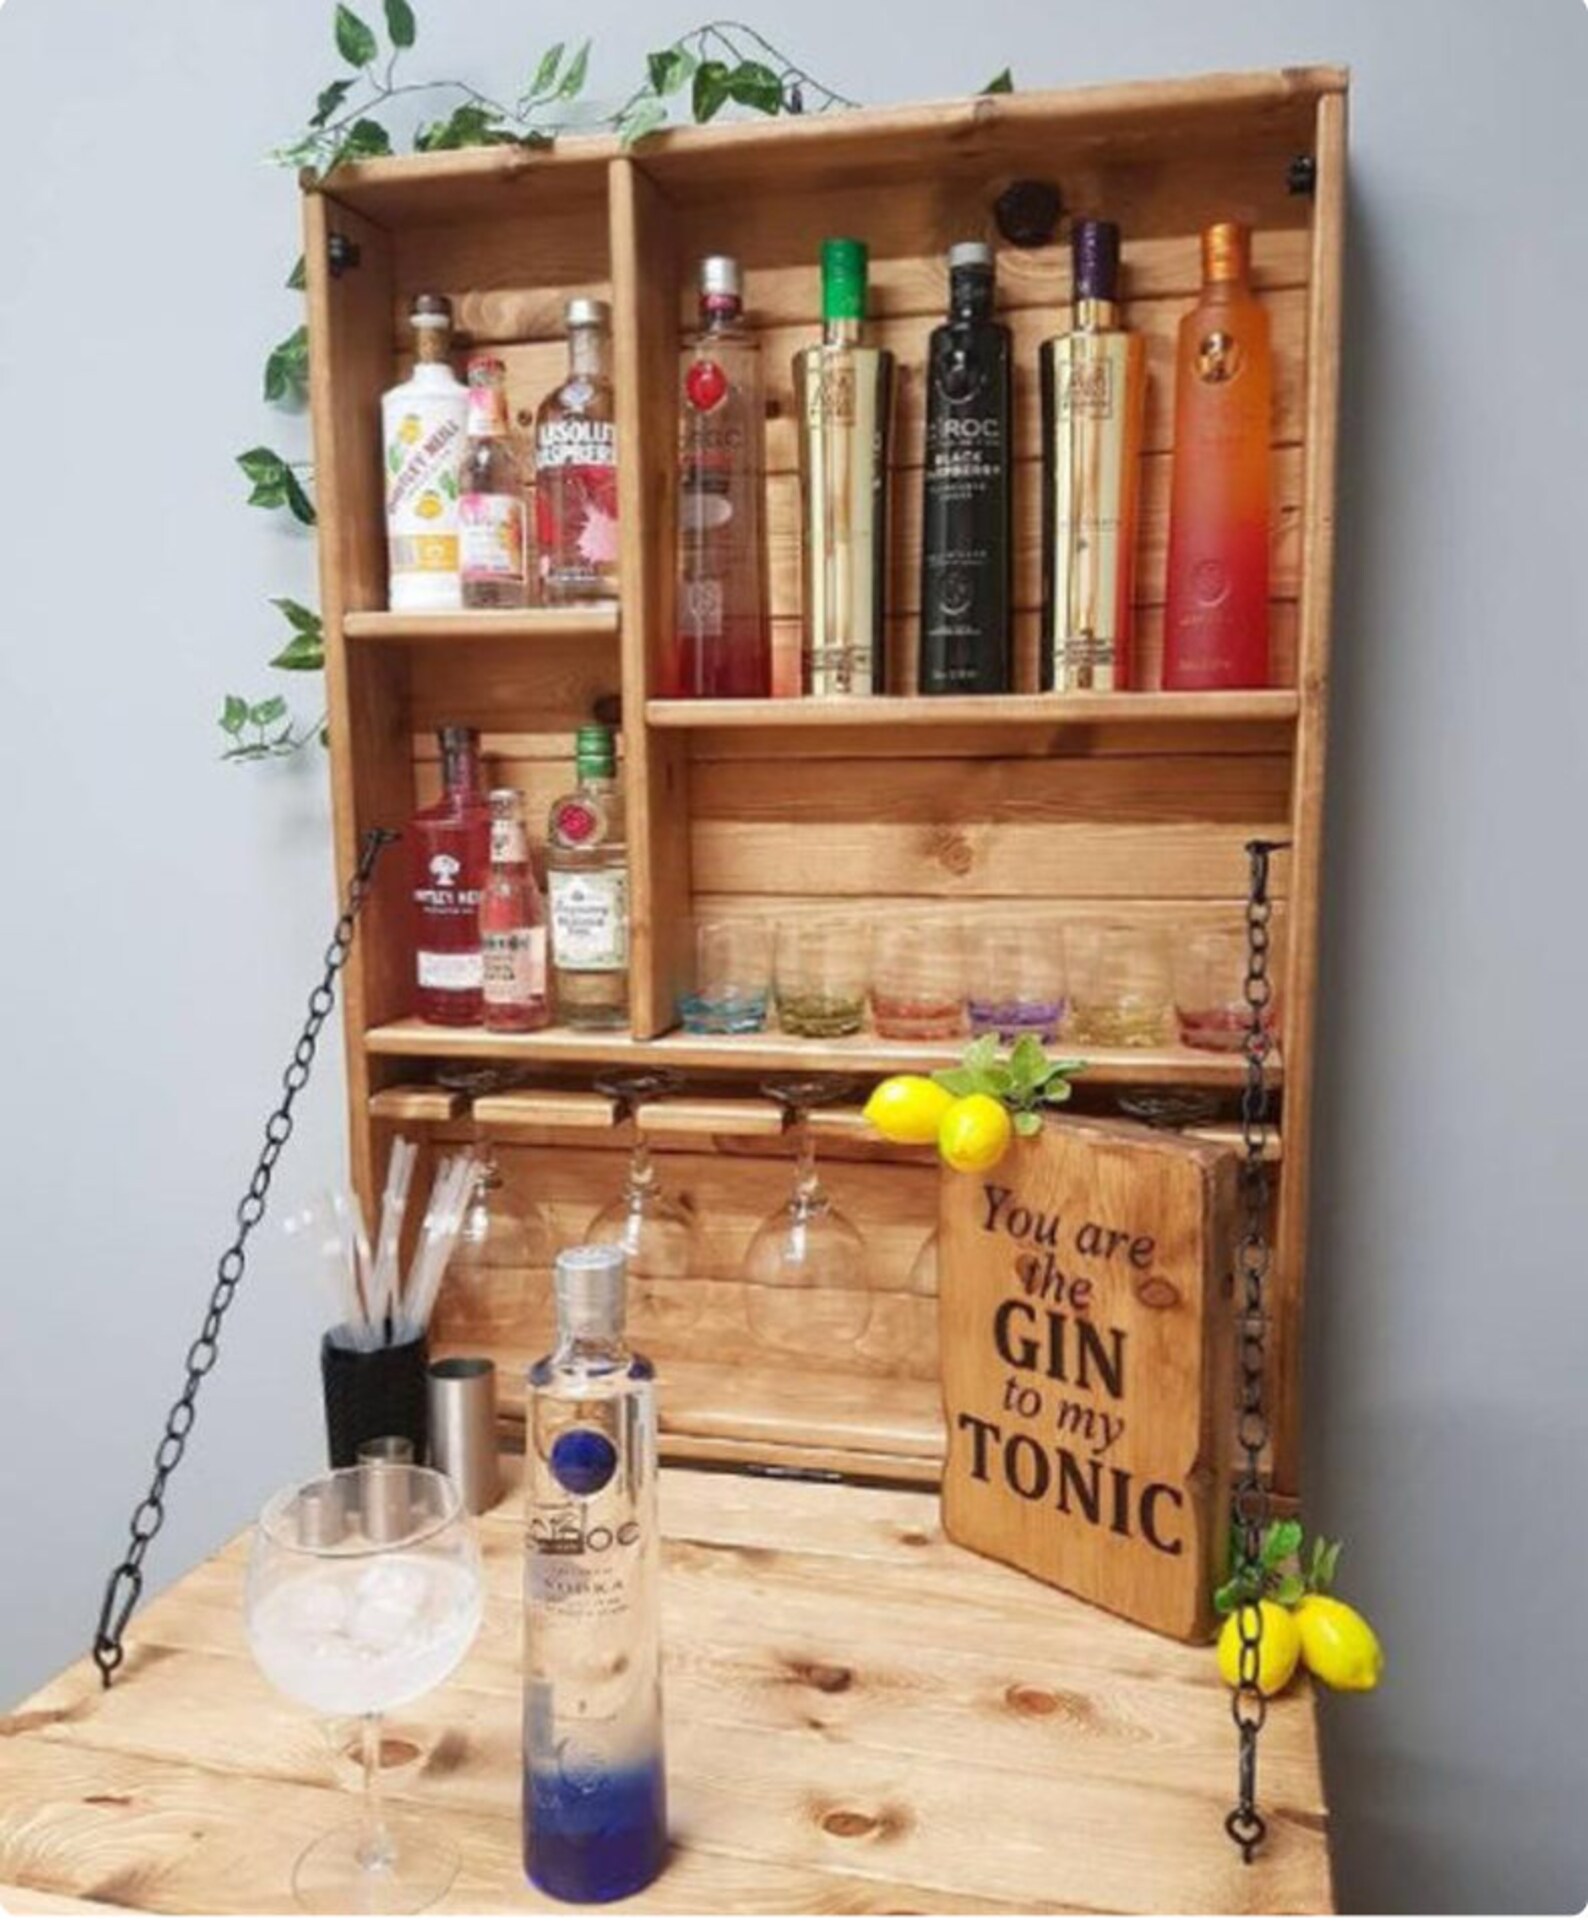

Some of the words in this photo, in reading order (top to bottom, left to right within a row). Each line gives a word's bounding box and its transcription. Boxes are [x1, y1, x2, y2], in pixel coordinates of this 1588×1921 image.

[982, 1183, 1060, 1247] You
[1076, 1222, 1156, 1270] are
[1018, 1252, 1093, 1311] the
[993, 1298, 1127, 1400] GIN
[1002, 1376, 1043, 1419] to
[1057, 1399, 1125, 1456] my
[957, 1411, 1184, 1556] TONIC
